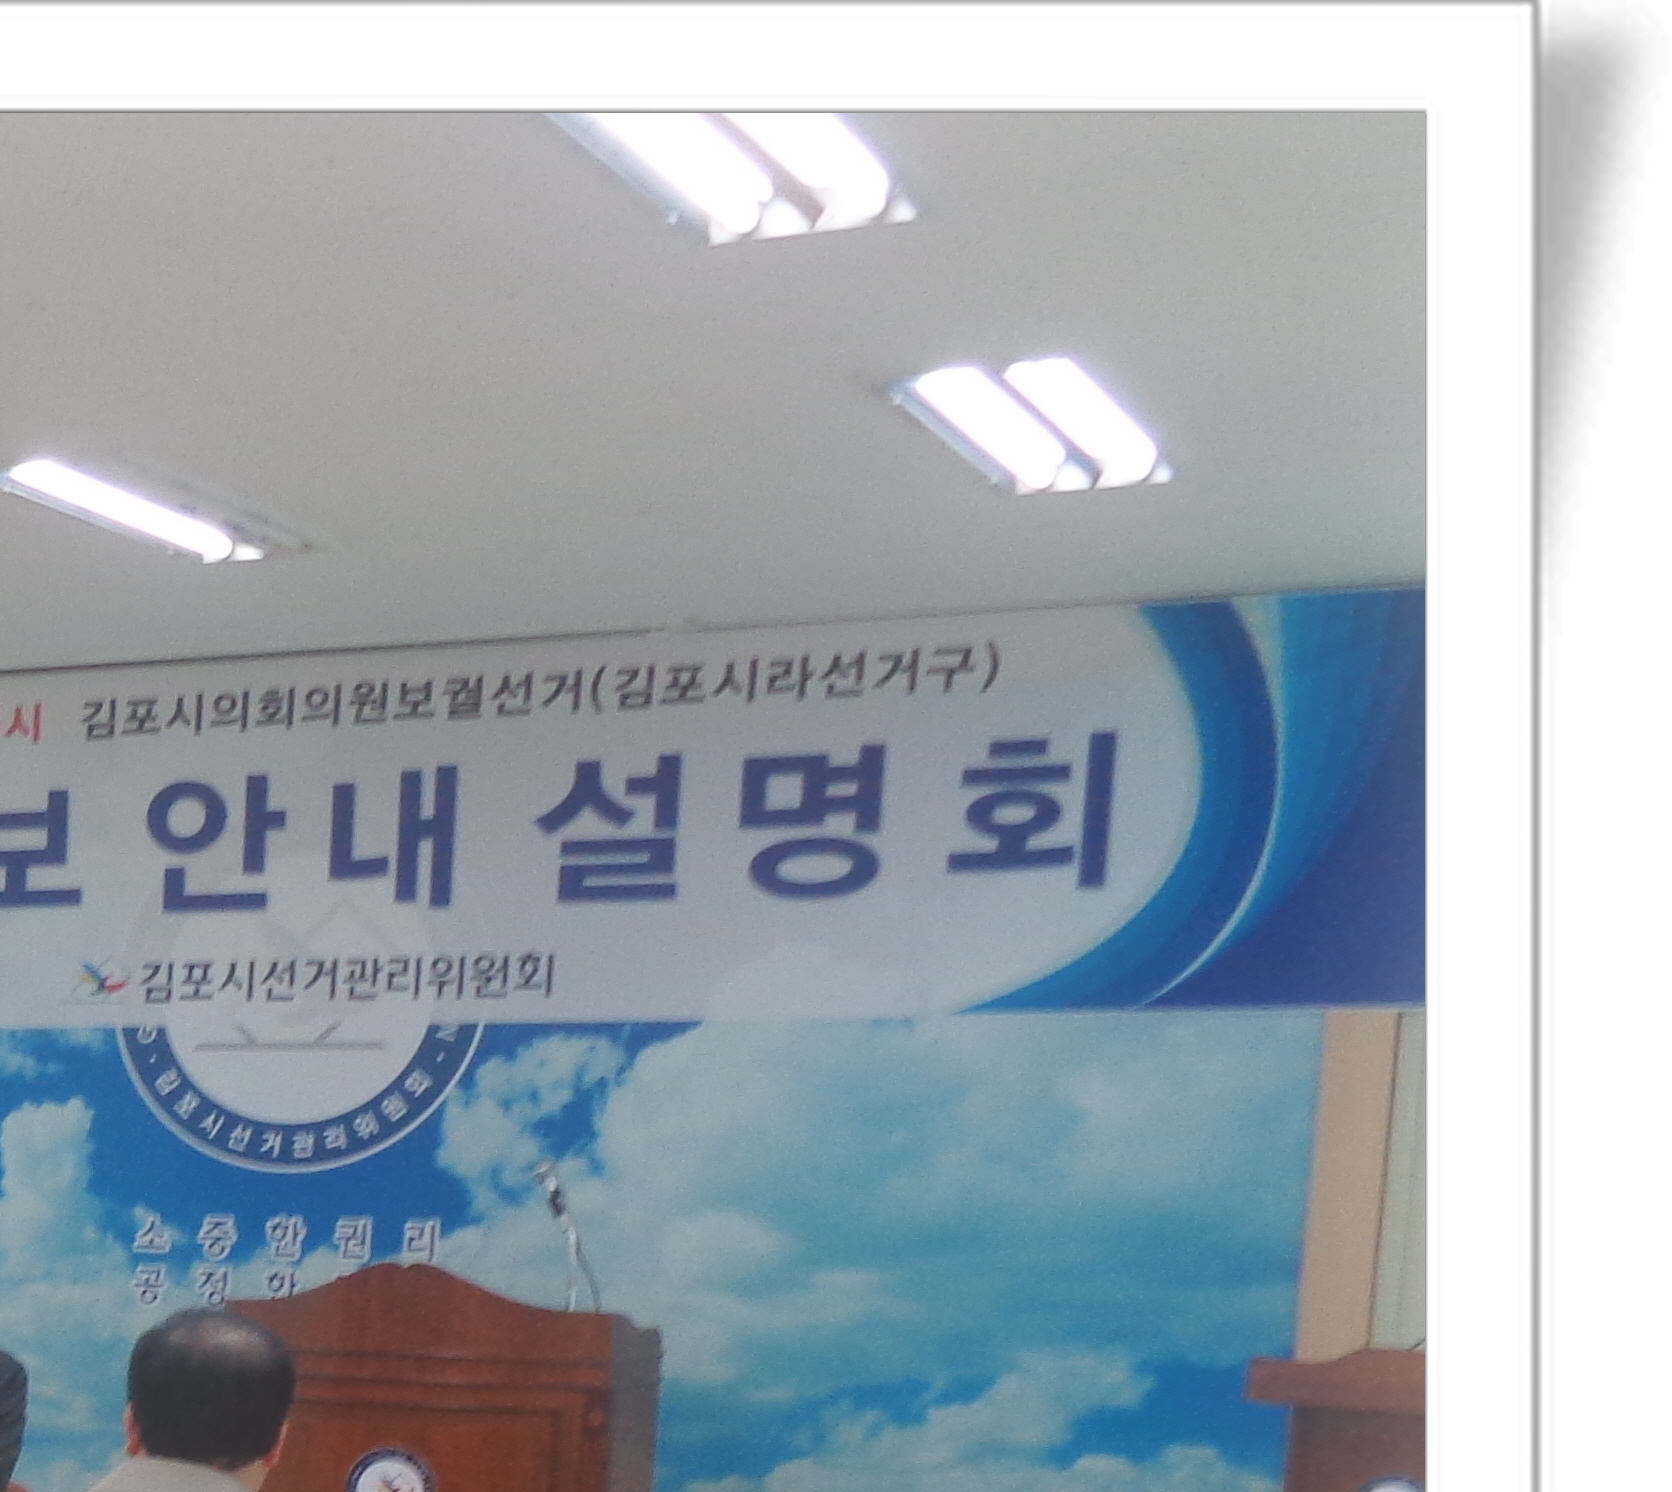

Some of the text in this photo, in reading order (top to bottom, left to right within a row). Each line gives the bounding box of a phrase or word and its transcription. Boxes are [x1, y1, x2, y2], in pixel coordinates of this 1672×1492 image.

[144, 764, 458, 914] 안내
[532, 729, 1120, 906] 설명회
[139, 952, 557, 1004] 김포시선거관리위원회
